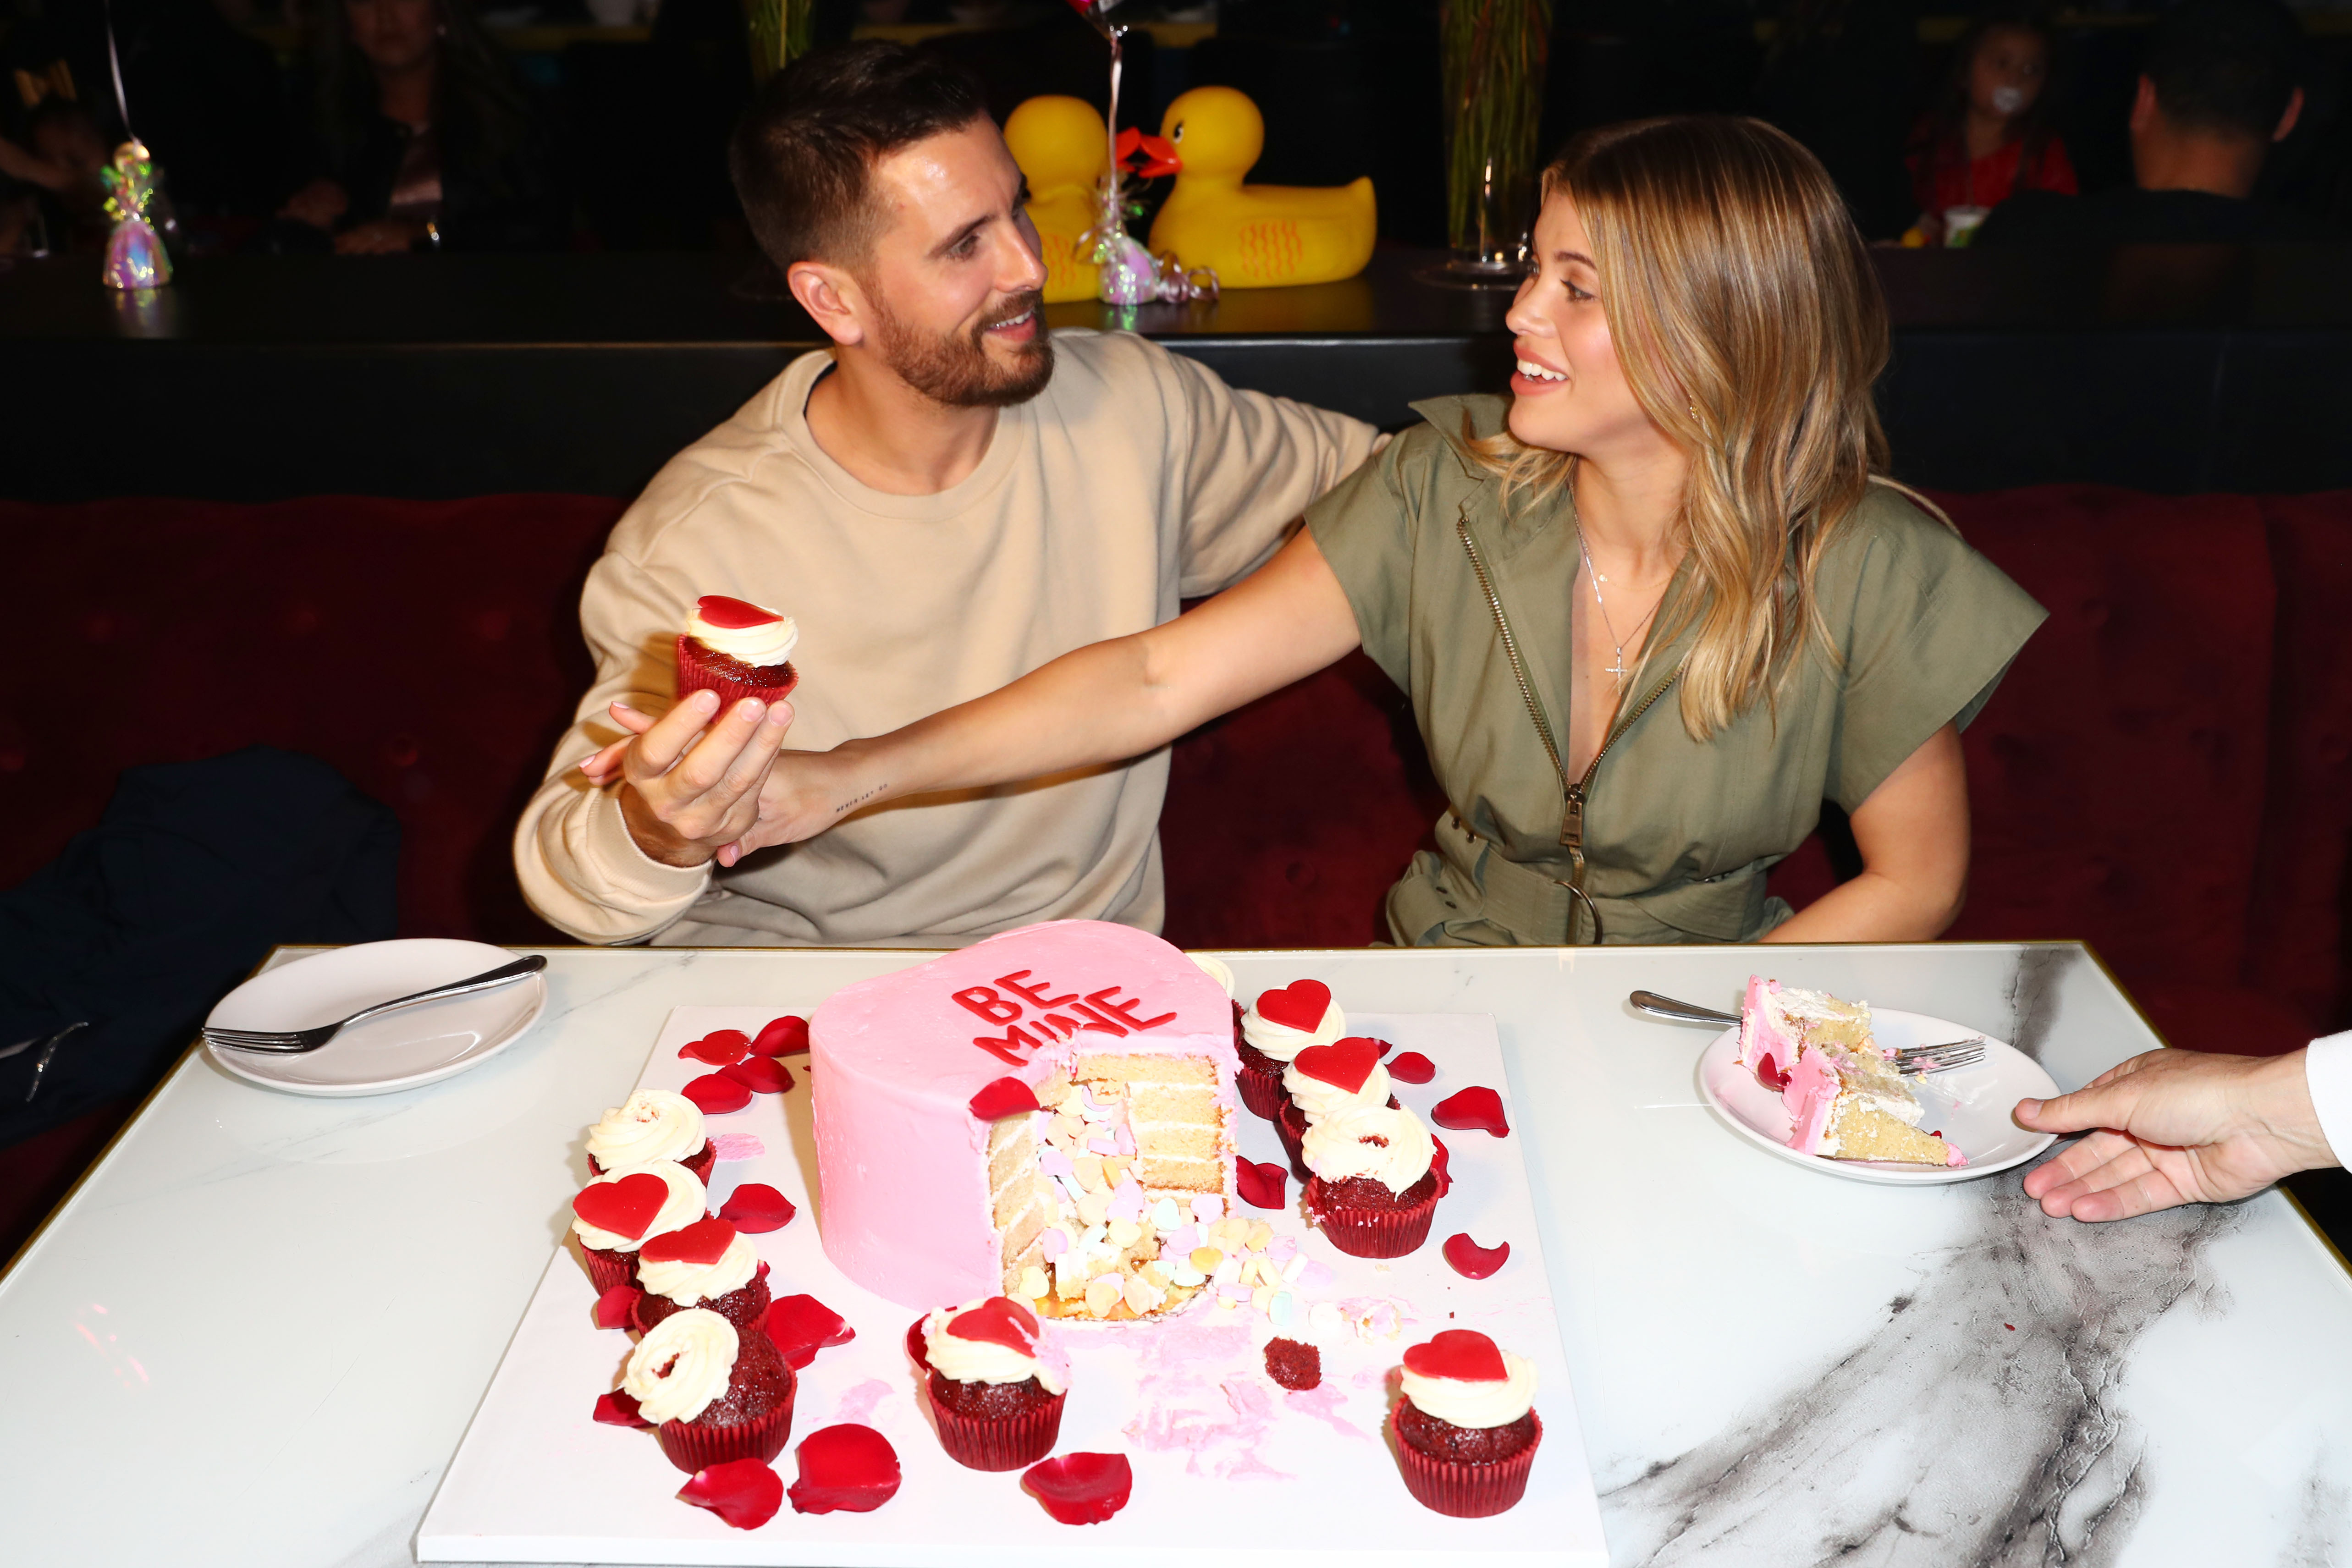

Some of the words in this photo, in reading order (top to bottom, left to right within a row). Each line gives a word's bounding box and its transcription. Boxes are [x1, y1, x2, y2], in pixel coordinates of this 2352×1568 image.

[836, 798, 858, 812] NEVER
[951, 969, 1079, 1026] BE
[973, 986, 1177, 1067] MINE
